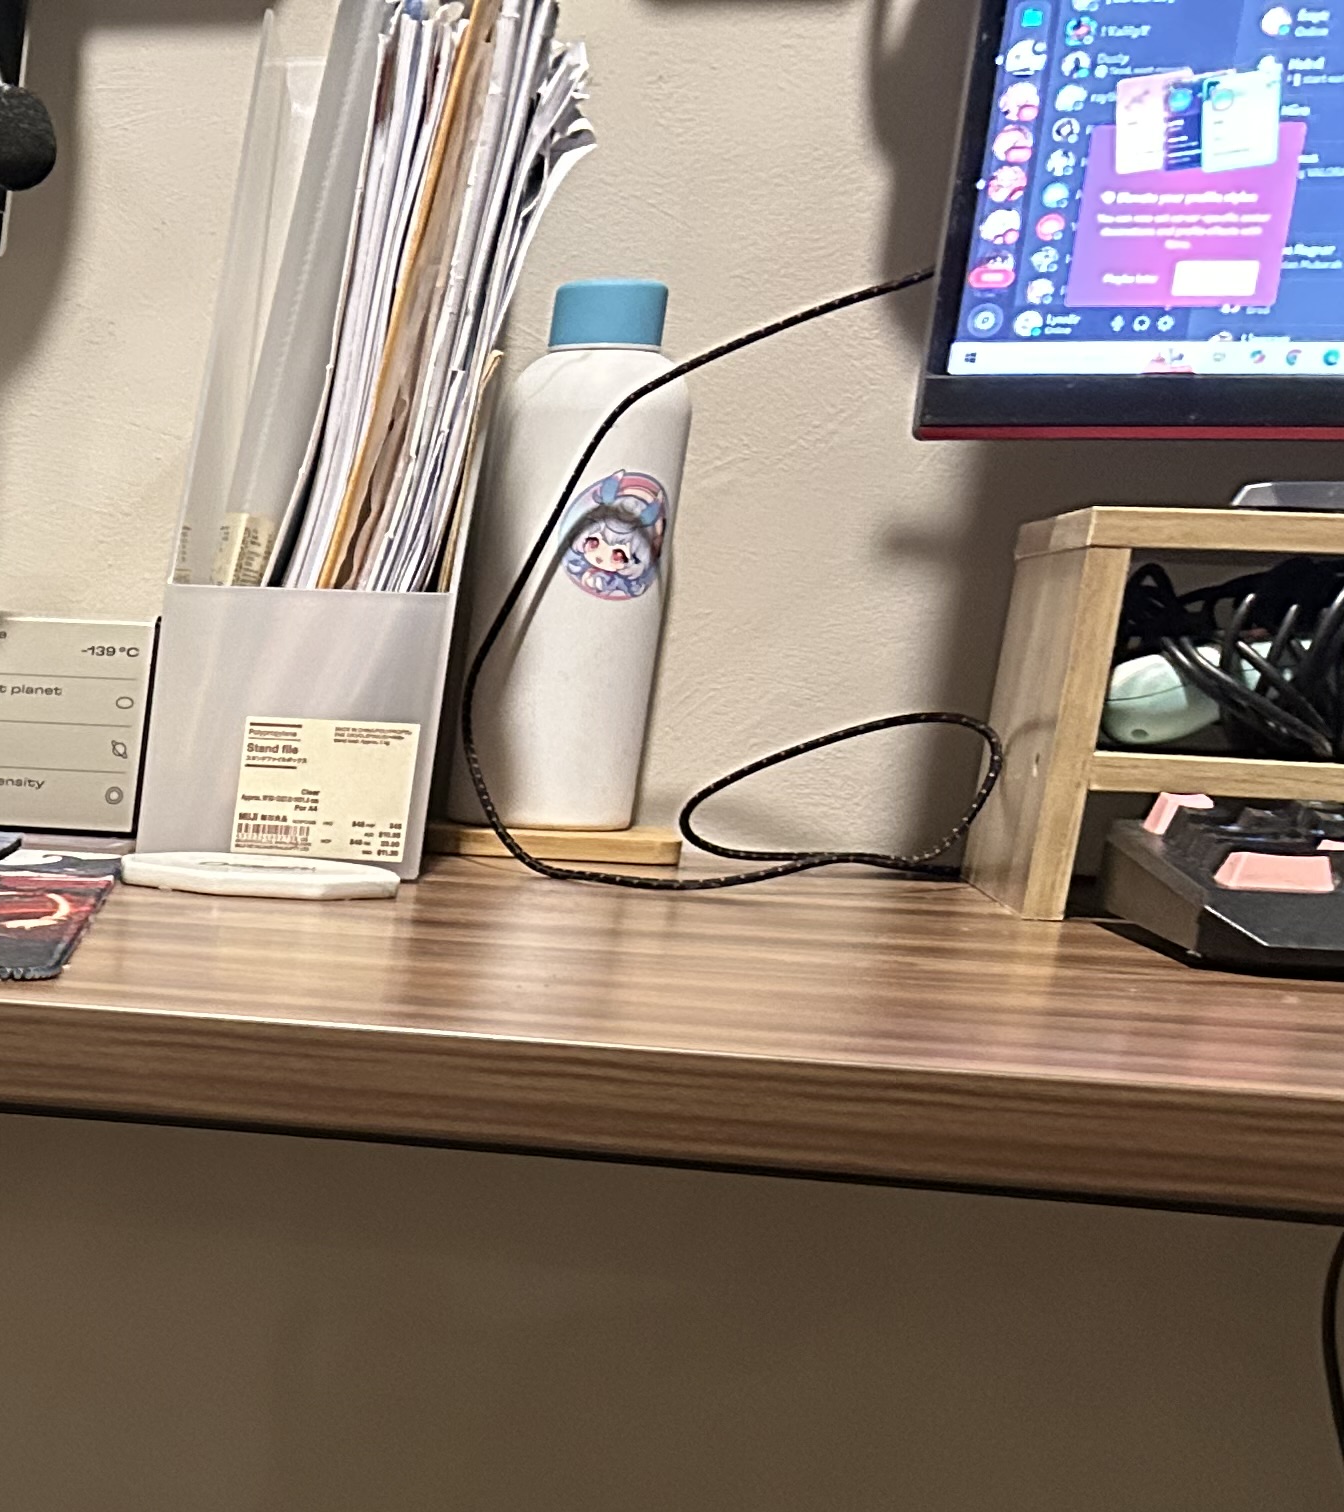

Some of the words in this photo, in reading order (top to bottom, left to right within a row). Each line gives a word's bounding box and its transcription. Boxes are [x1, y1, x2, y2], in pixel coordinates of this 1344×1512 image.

[10, 684, 63, 697] planet
[247, 743, 279, 753] Stand
[282, 745, 298, 754] file
